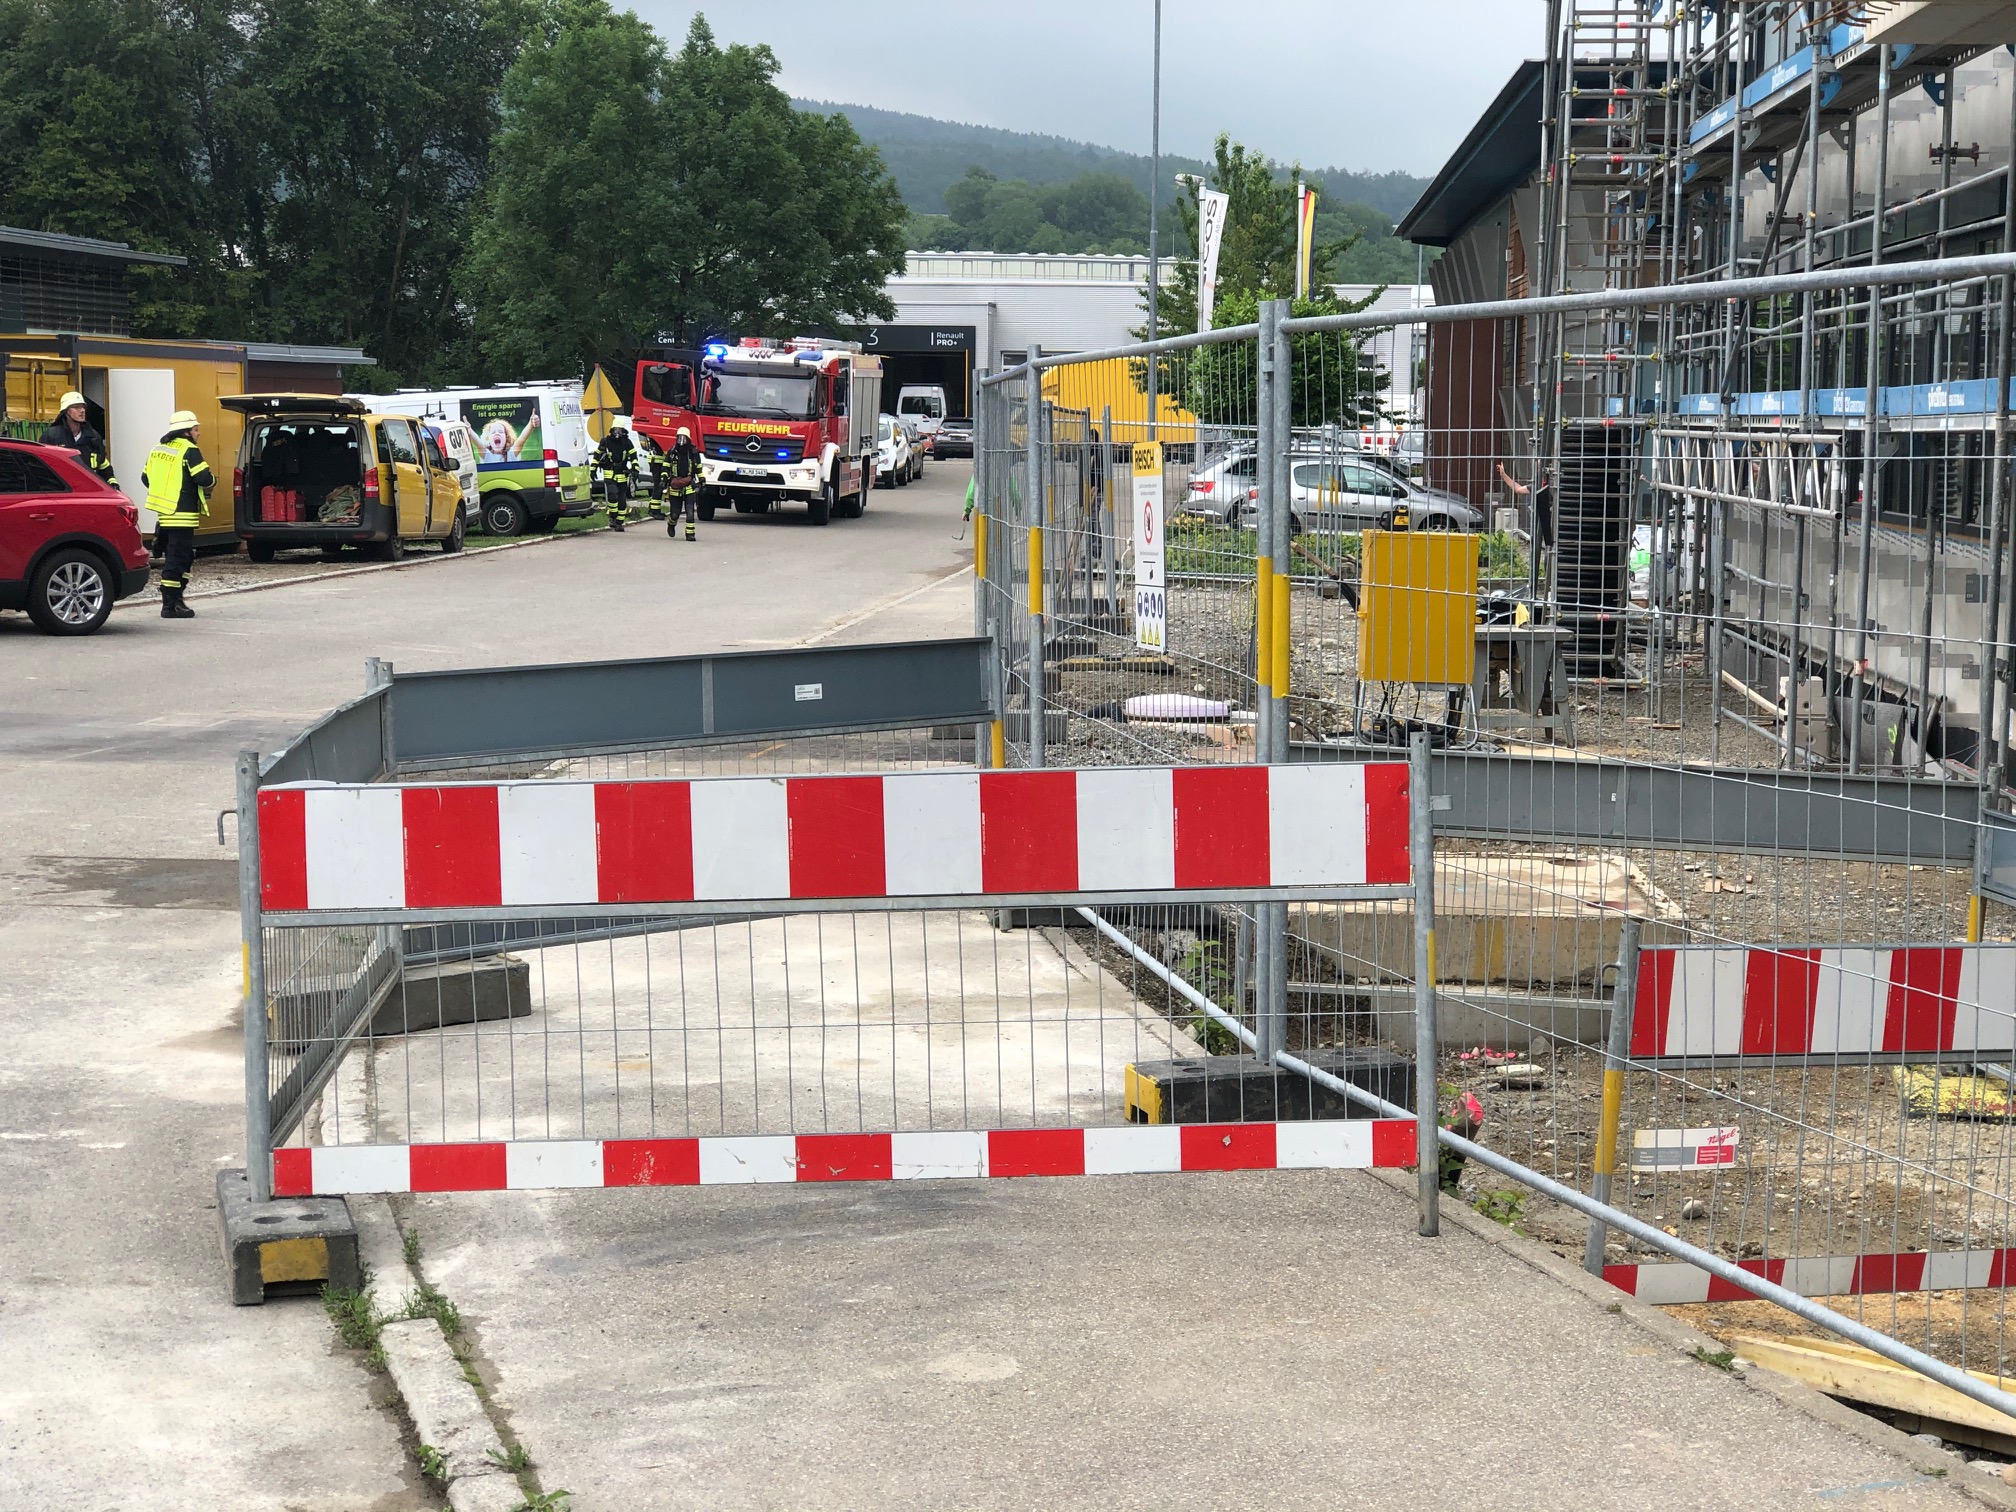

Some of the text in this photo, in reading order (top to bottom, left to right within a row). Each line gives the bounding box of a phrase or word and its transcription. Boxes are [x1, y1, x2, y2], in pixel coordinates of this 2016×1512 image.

[866, 327, 879, 346] 3
[472, 403, 522, 411] Energie sparen
[498, 410, 516, 418] easy!
[717, 421, 791, 434] FEUERWEHR
